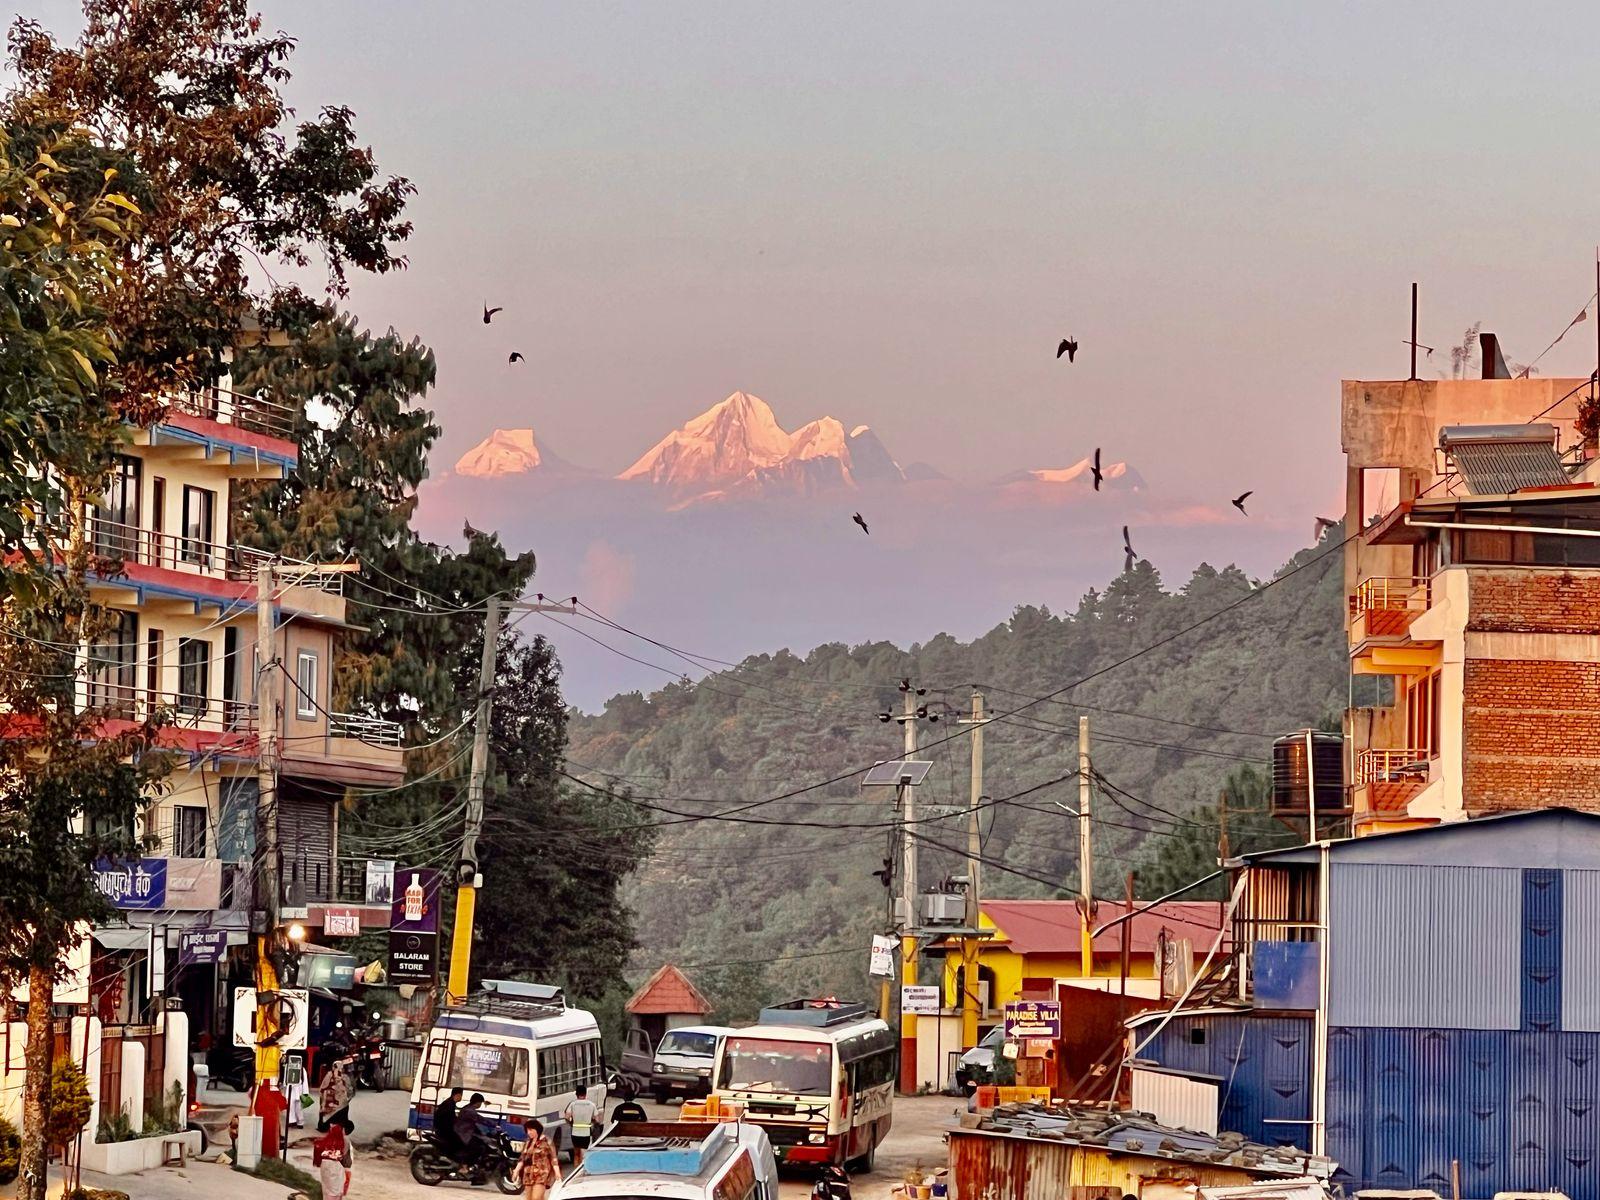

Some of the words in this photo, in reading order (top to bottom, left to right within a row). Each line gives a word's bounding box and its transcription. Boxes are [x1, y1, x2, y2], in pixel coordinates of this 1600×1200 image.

[393, 952, 430, 961] BALARAM
[399, 963, 424, 971] STORE
[1006, 1011, 1038, 1021] PARADISE
[1040, 1011, 1059, 1021] VILLA
